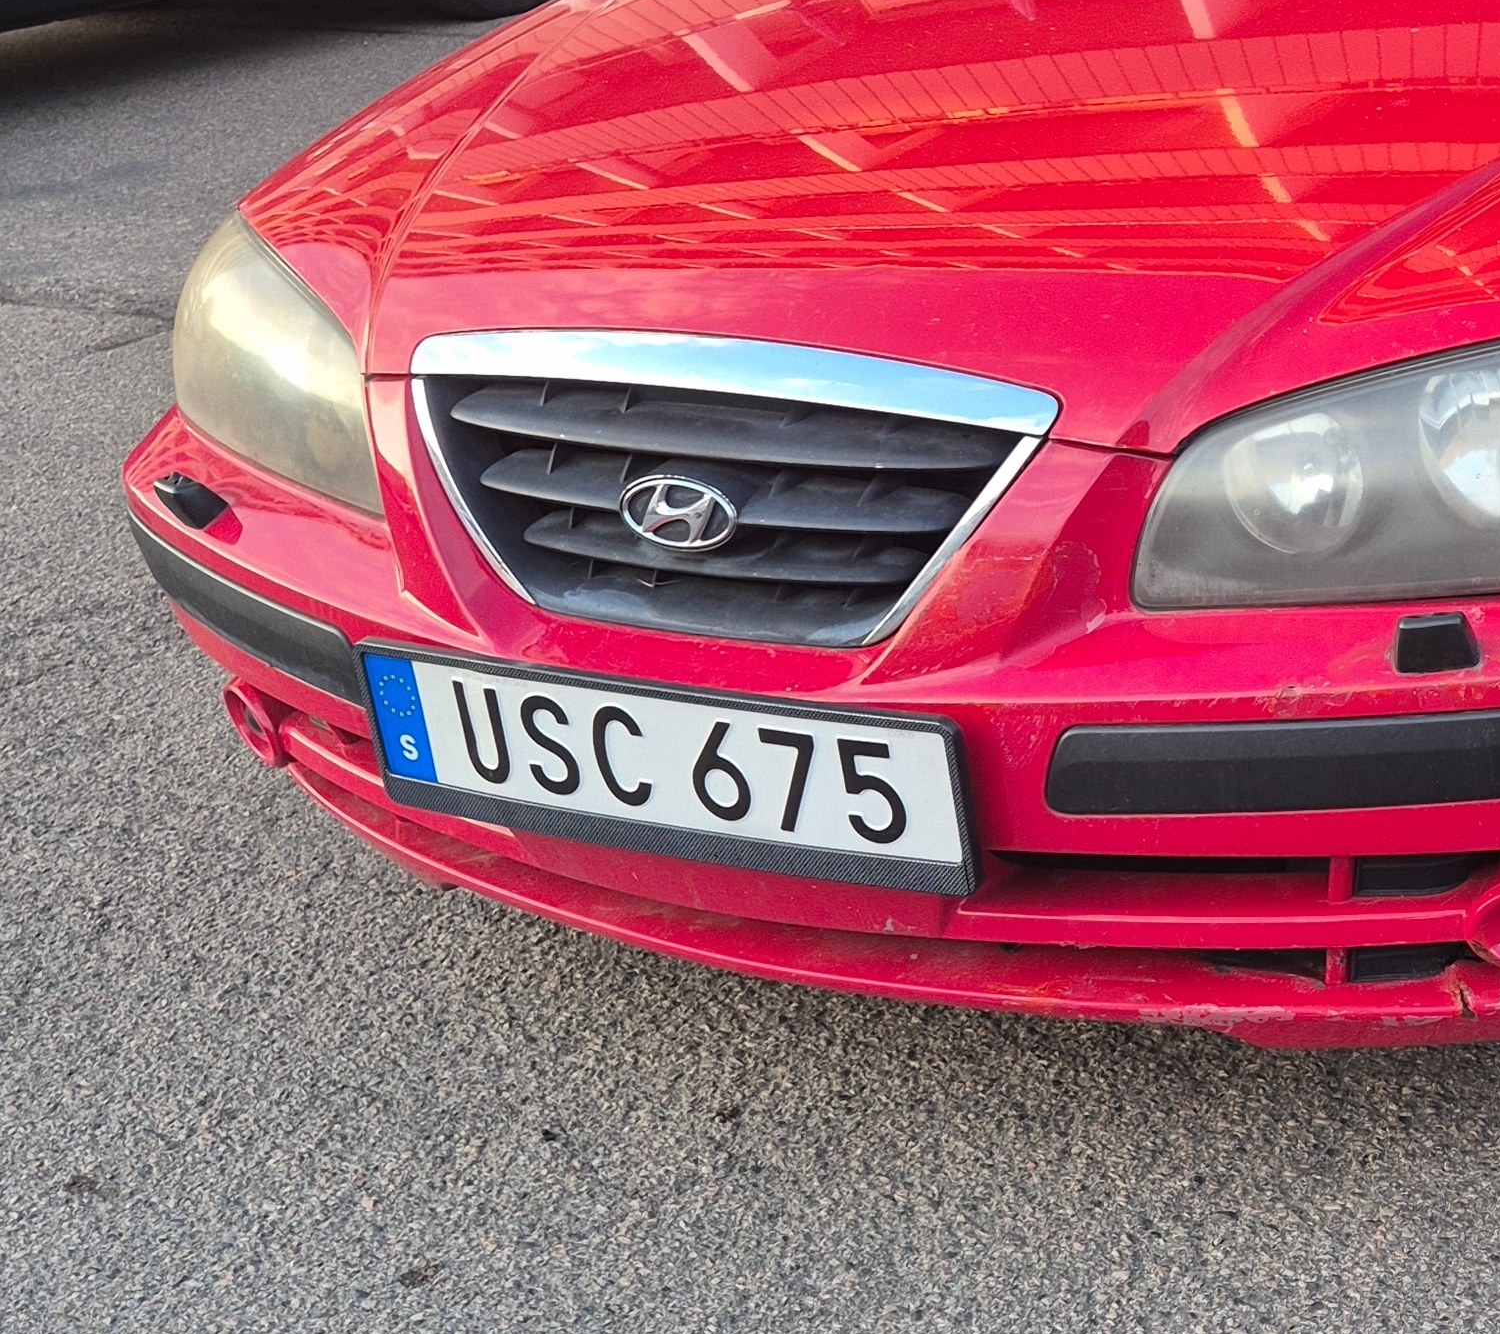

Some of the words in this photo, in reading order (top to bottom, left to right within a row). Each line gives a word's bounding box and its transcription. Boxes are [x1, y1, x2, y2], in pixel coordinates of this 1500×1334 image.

[400, 733, 420, 761] S
[451, 678, 653, 807] USC
[692, 720, 908, 845] 675
